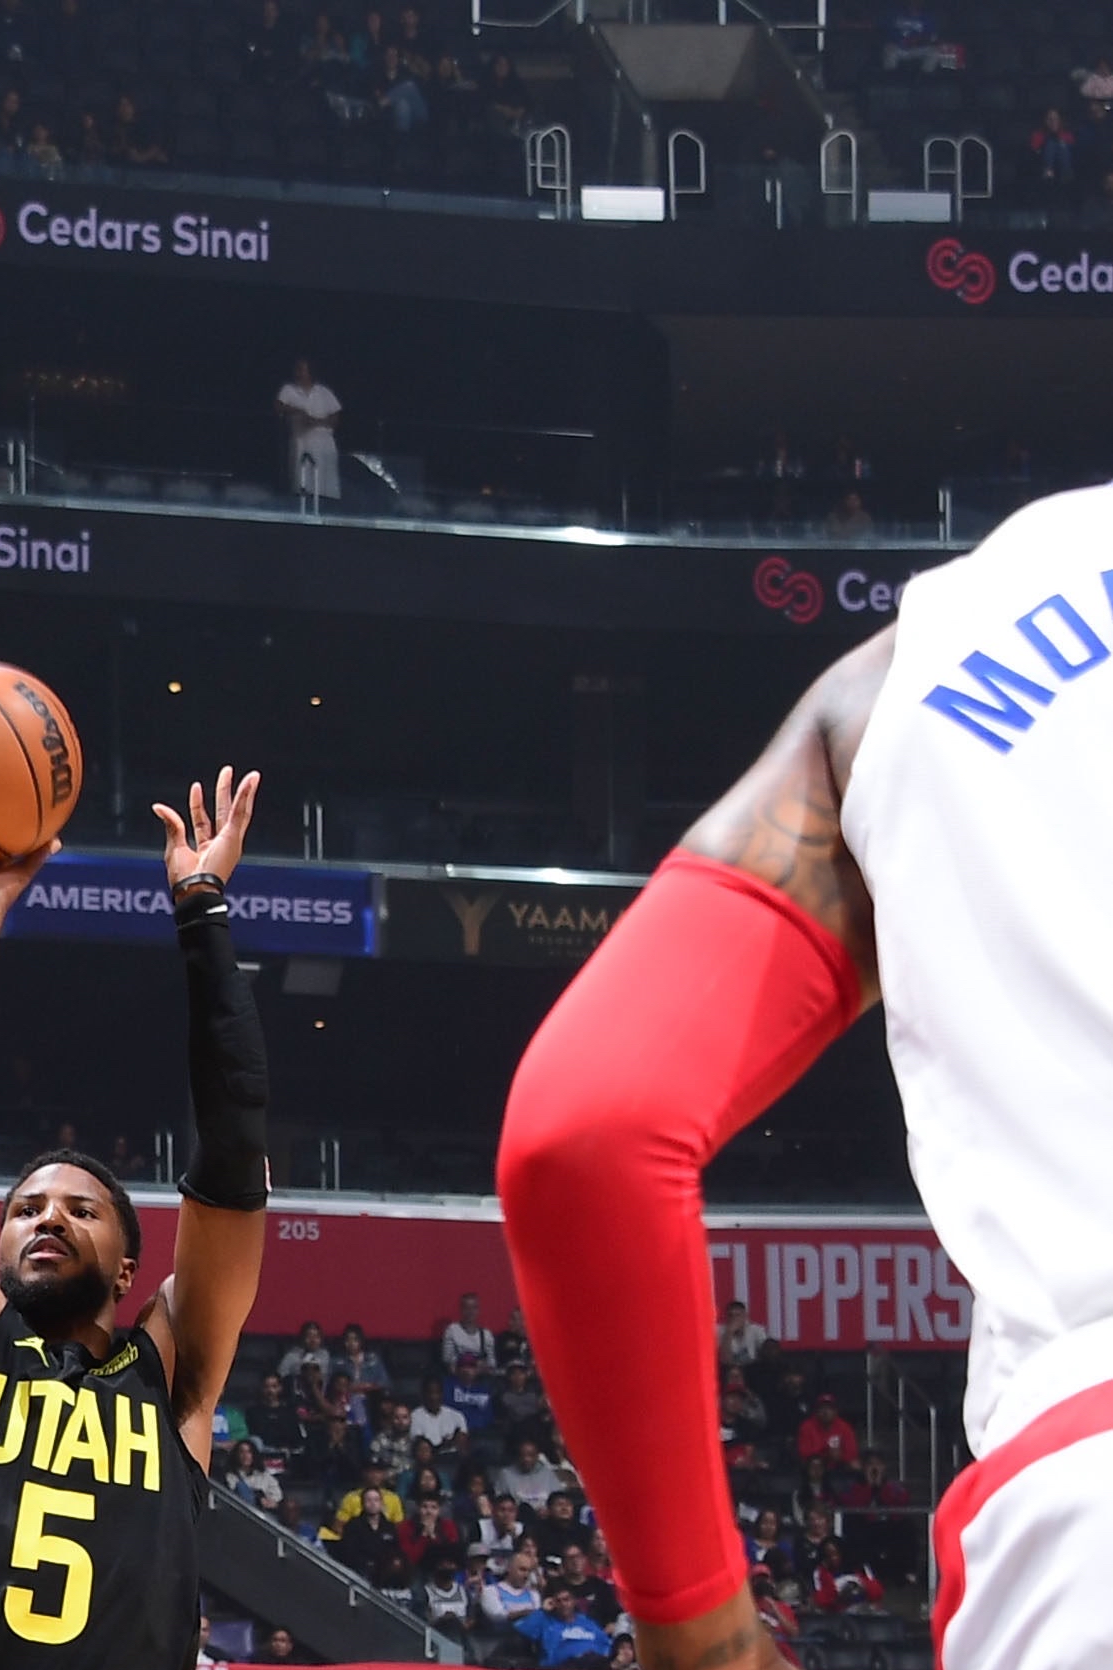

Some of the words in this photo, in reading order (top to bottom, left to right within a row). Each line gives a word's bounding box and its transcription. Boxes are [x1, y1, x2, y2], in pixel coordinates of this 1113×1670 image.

[18, 203, 162, 253] Cedars
[172, 214, 269, 261] Sinai
[1009, 252, 1113, 293] Ceda
[837, 571, 911, 612] Ce
[920, 568, 1113, 756] MO
[26, 884, 174, 915] AMERICA
[224, 893, 353, 925] XPRESS
[508, 902, 625, 932] YAAM
[278, 1220, 320, 1240] 205
[3, 1480, 96, 1645] 5
